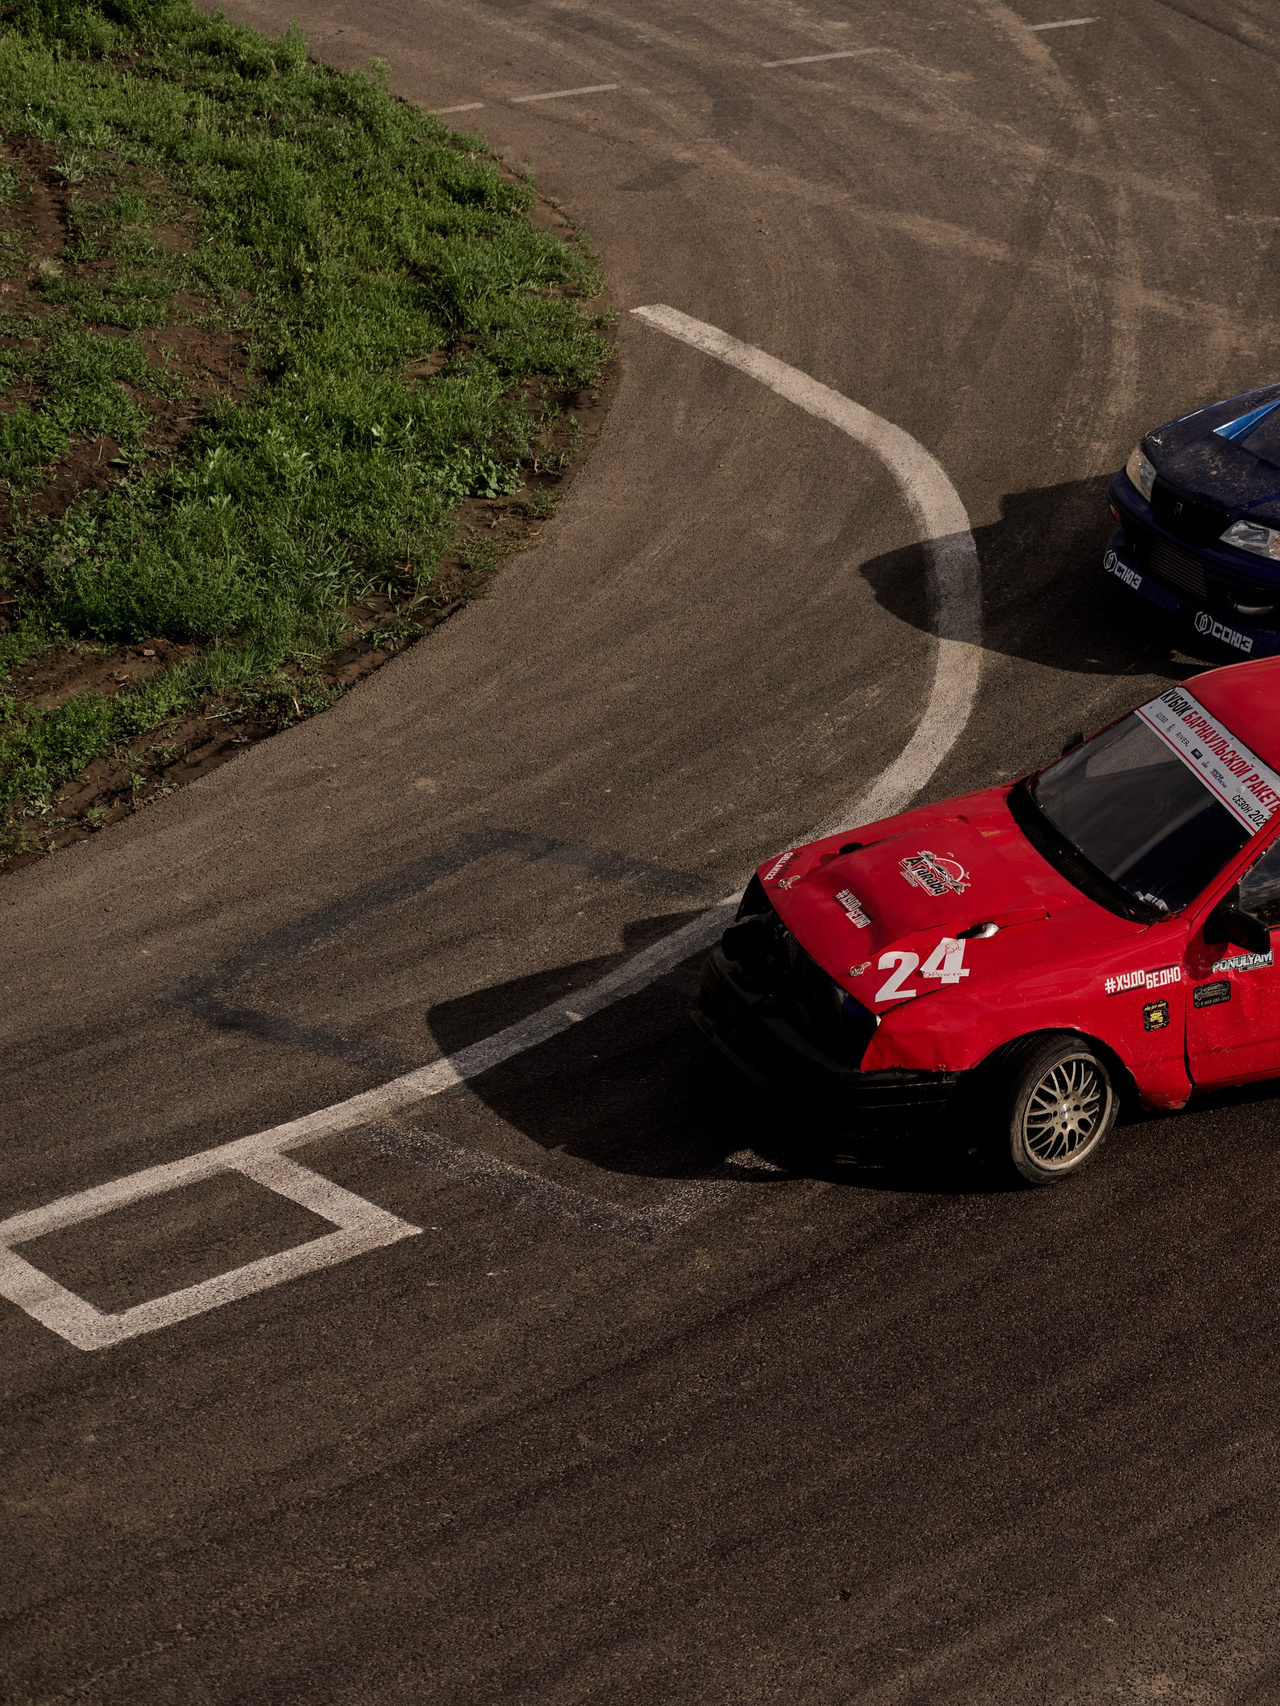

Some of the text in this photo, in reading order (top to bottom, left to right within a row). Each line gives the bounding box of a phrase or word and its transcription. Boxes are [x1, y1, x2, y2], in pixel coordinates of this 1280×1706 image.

[1211, 621, 1253, 653] СОЮЗ
[1159, 689, 1193, 717] КУБОК
[1181, 710, 1256, 779] БАРНАУЛЬСКОЙ
[1232, 794, 1253, 814] СЕЗОН
[875, 937, 970, 1003] 24
